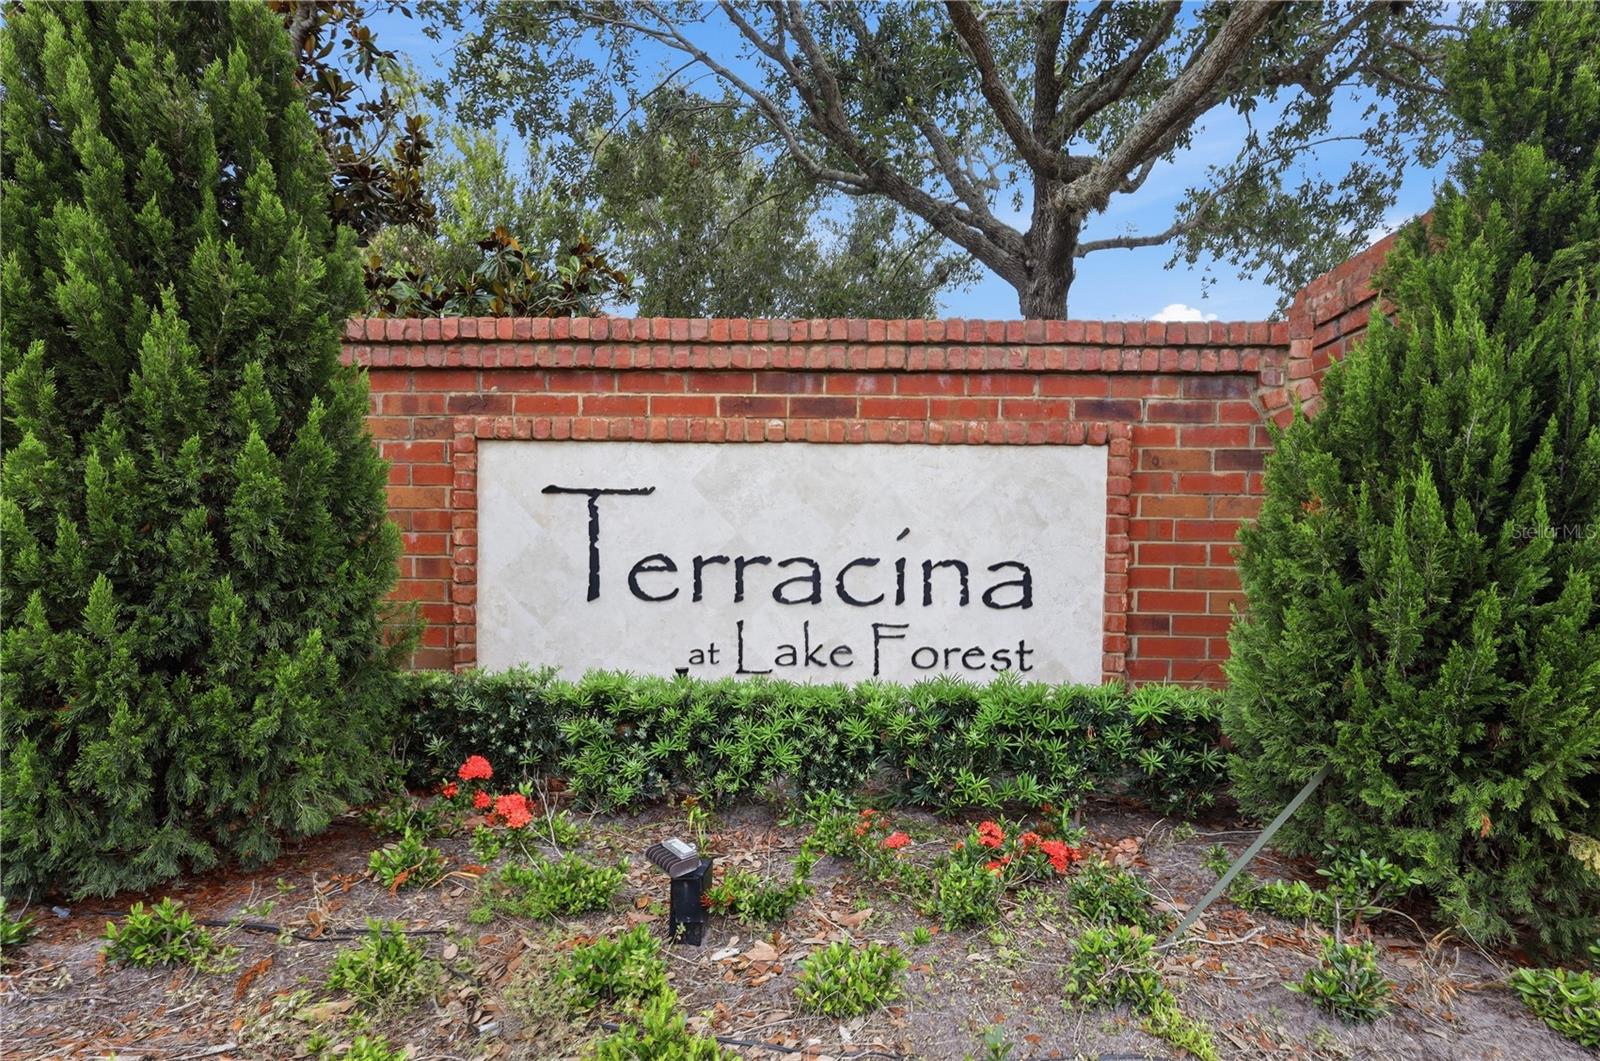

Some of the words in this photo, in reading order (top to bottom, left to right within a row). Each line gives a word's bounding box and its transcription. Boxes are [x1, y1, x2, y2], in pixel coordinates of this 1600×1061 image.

[541, 485, 1034, 609] Terracina
[689, 638, 719, 666] at
[735, 619, 853, 675] Lake
[870, 622, 1035, 675] Forest
